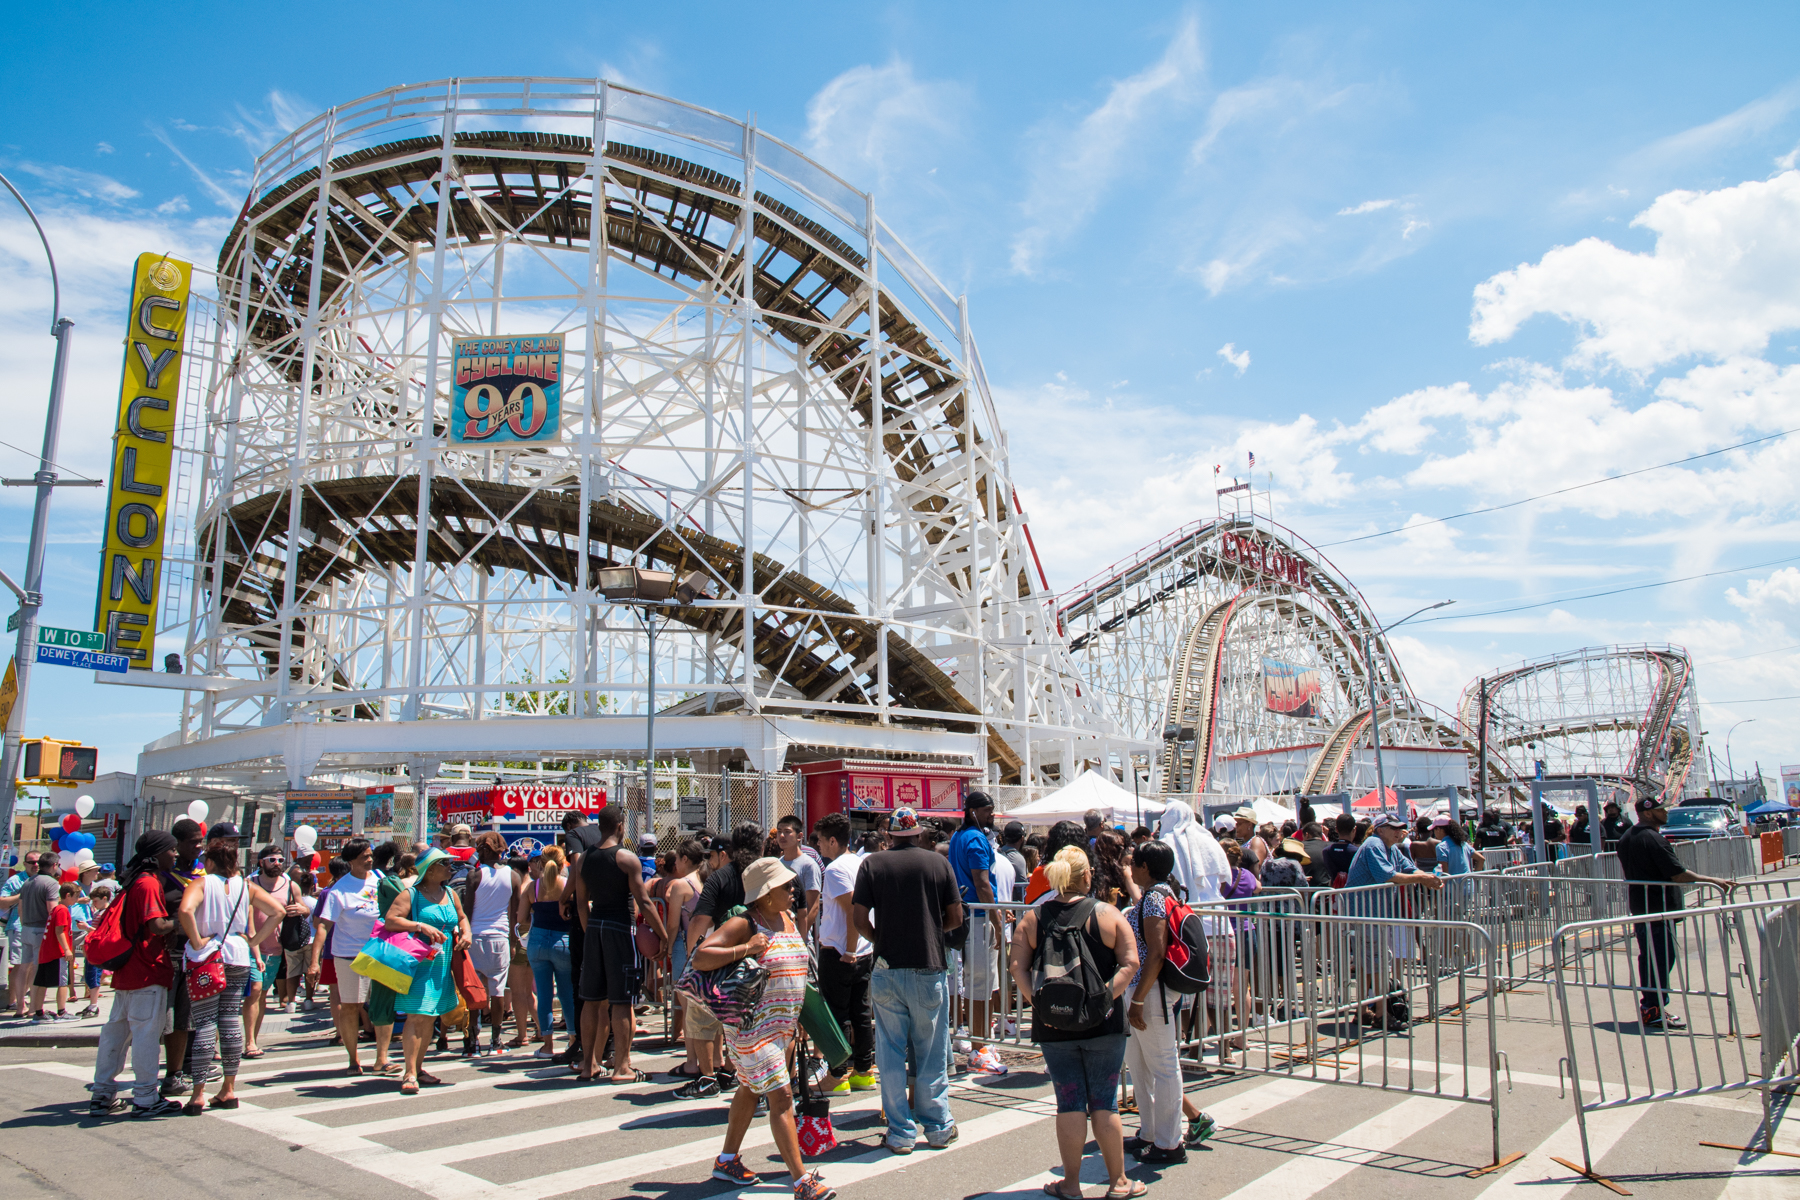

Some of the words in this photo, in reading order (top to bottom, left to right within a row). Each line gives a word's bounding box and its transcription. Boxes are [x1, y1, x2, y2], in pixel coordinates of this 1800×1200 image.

[458, 342, 479, 356] THE
[481, 340, 518, 355] CONEY
[520, 338, 560, 353] ISLAND
[456, 353, 560, 385] CYCLONE
[463, 381, 548, 441] 90
[491, 401, 521, 425] YEARS
[105, 295, 181, 661] CYCLONE
[1223, 531, 1310, 587] CYCLONE
[44, 628, 58, 643] W
[64, 631, 82, 646] 10
[87, 634, 98, 642] ST
[40, 646, 79, 661] DEWEY
[81, 653, 125, 668] ALBERT
[71, 660, 92, 669] PLACE
[441, 791, 490, 809] CYCLONE
[503, 790, 599, 809] CYCLONE
[854, 785, 865, 803] TEE
[866, 785, 884, 803] SHIRTS
[931, 781, 957, 807] SOUVENIRS
[448, 811, 482, 825] TICKETS
[525, 810, 569, 822] TICKE
